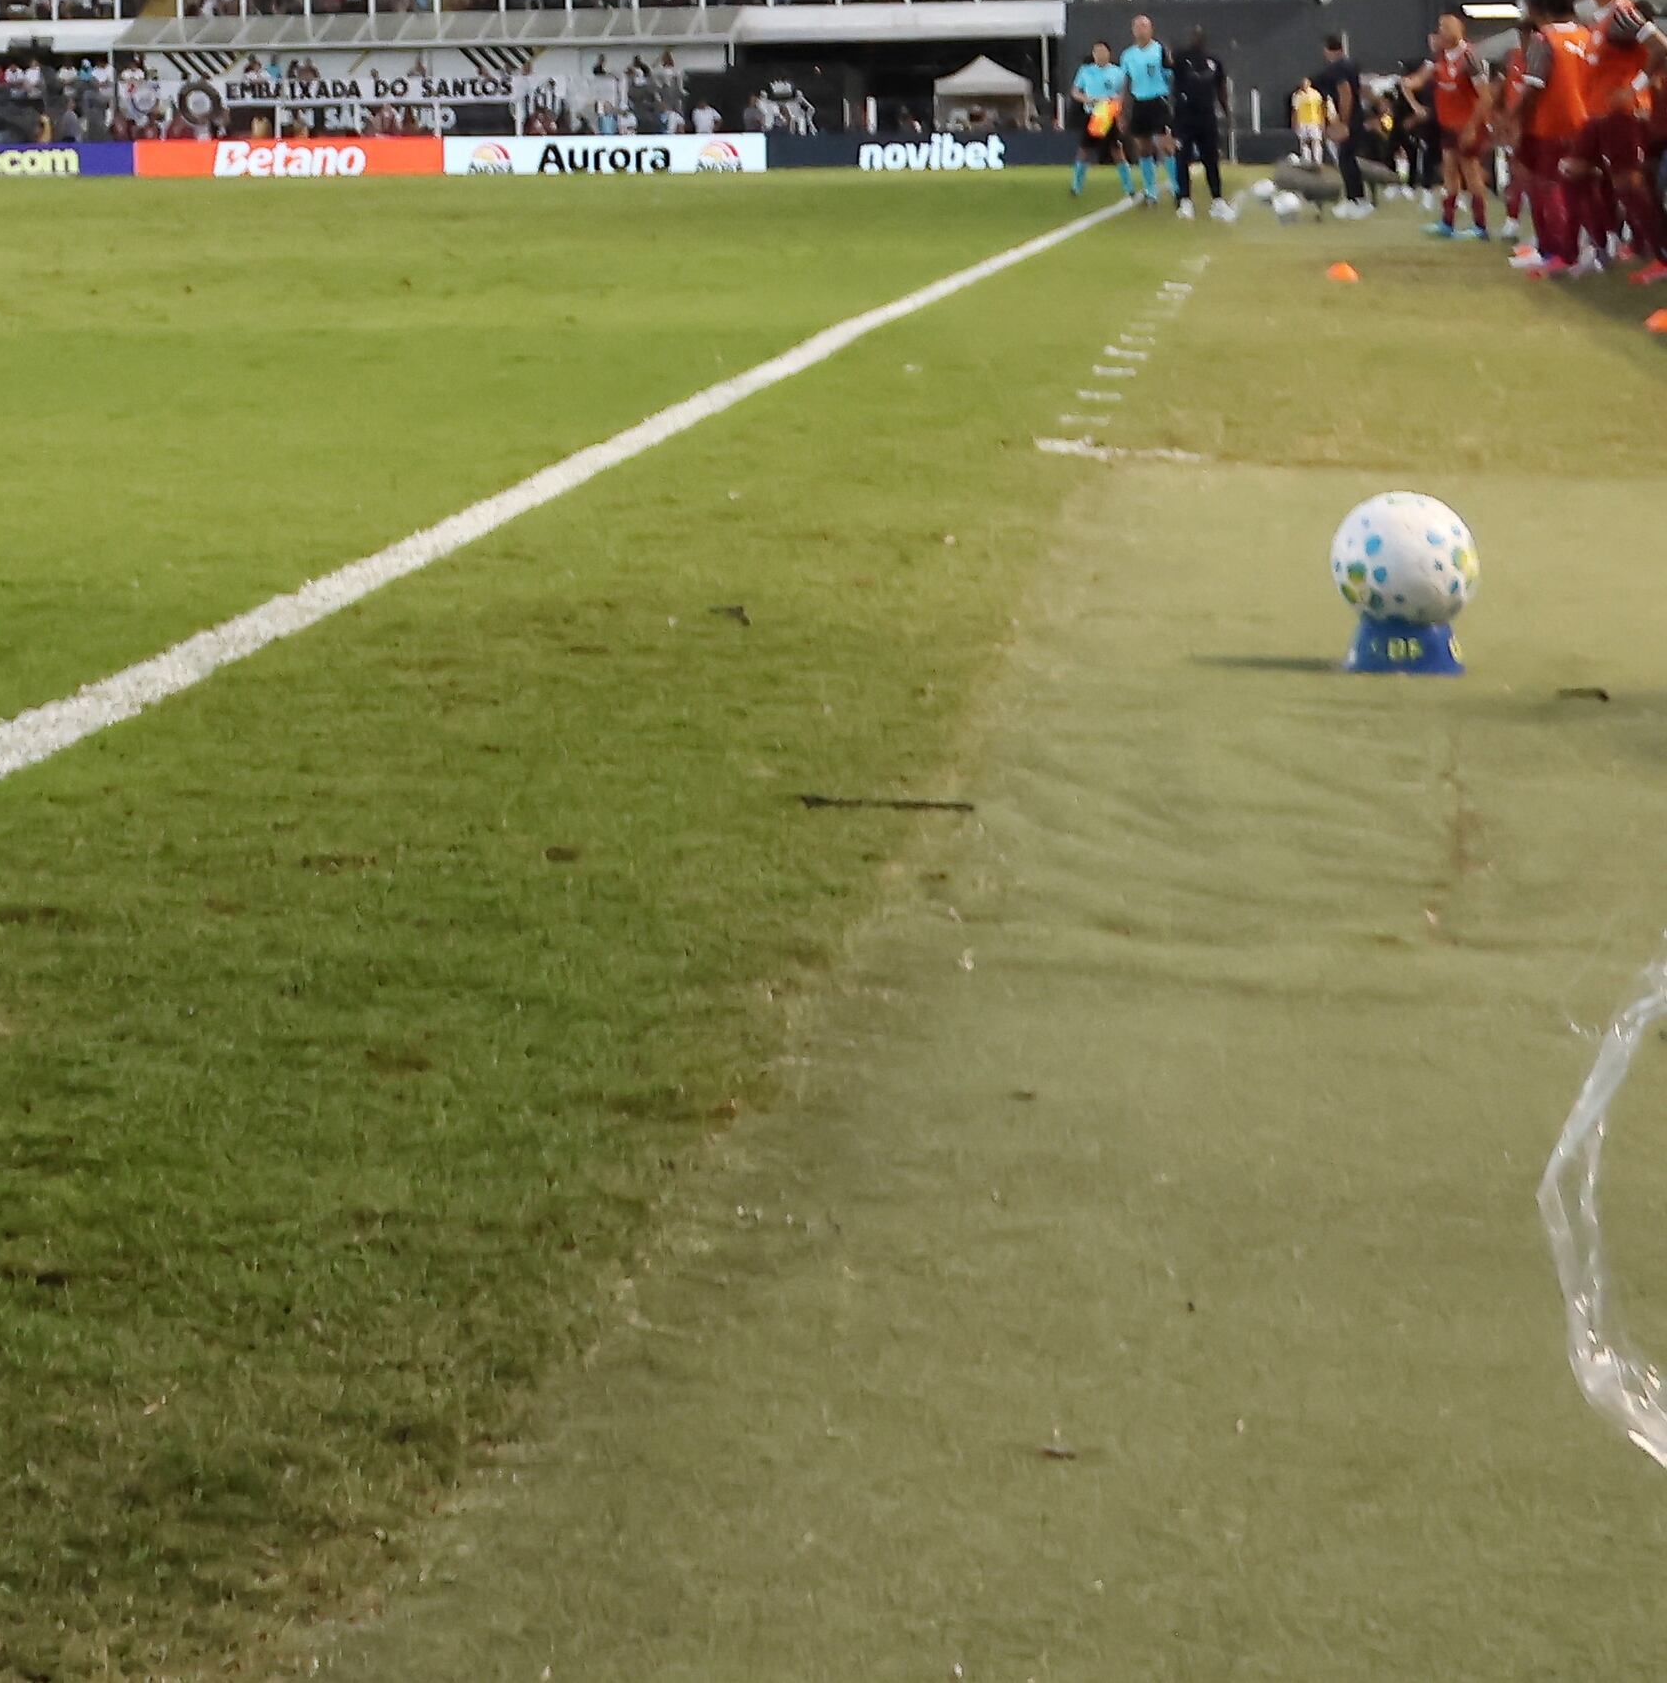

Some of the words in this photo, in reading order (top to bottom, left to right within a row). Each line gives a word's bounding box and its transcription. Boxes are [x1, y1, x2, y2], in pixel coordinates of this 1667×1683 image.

[375, 77, 408, 98] DO
[421, 77, 512, 98] SANTOS
[213, 138, 366, 176] Betano
[538, 143, 670, 173] Aurora
[858, 132, 1005, 171] novibet
